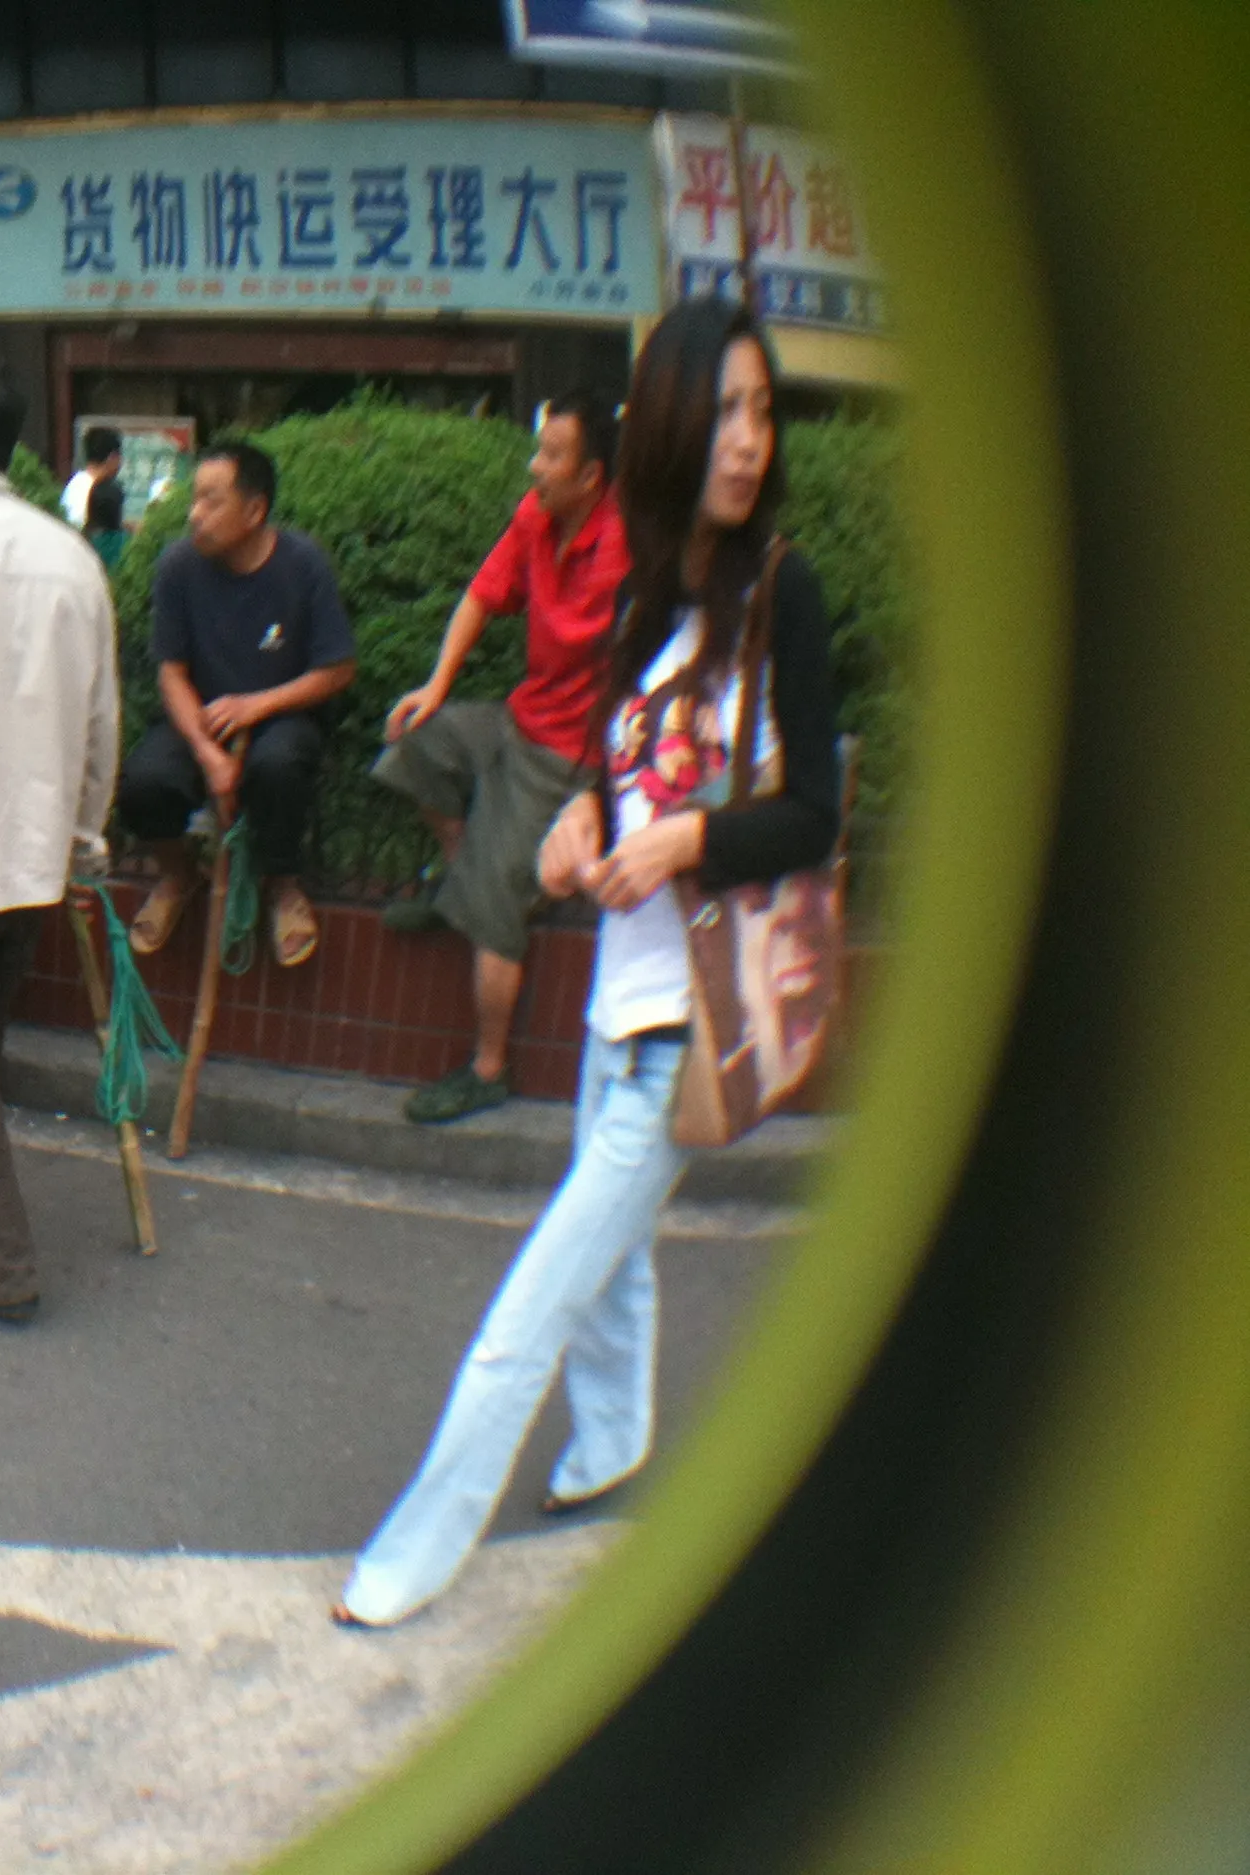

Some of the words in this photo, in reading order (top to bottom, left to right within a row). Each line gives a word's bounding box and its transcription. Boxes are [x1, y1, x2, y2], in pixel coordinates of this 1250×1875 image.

[59, 164, 628, 275] 货物快运受理大厅
